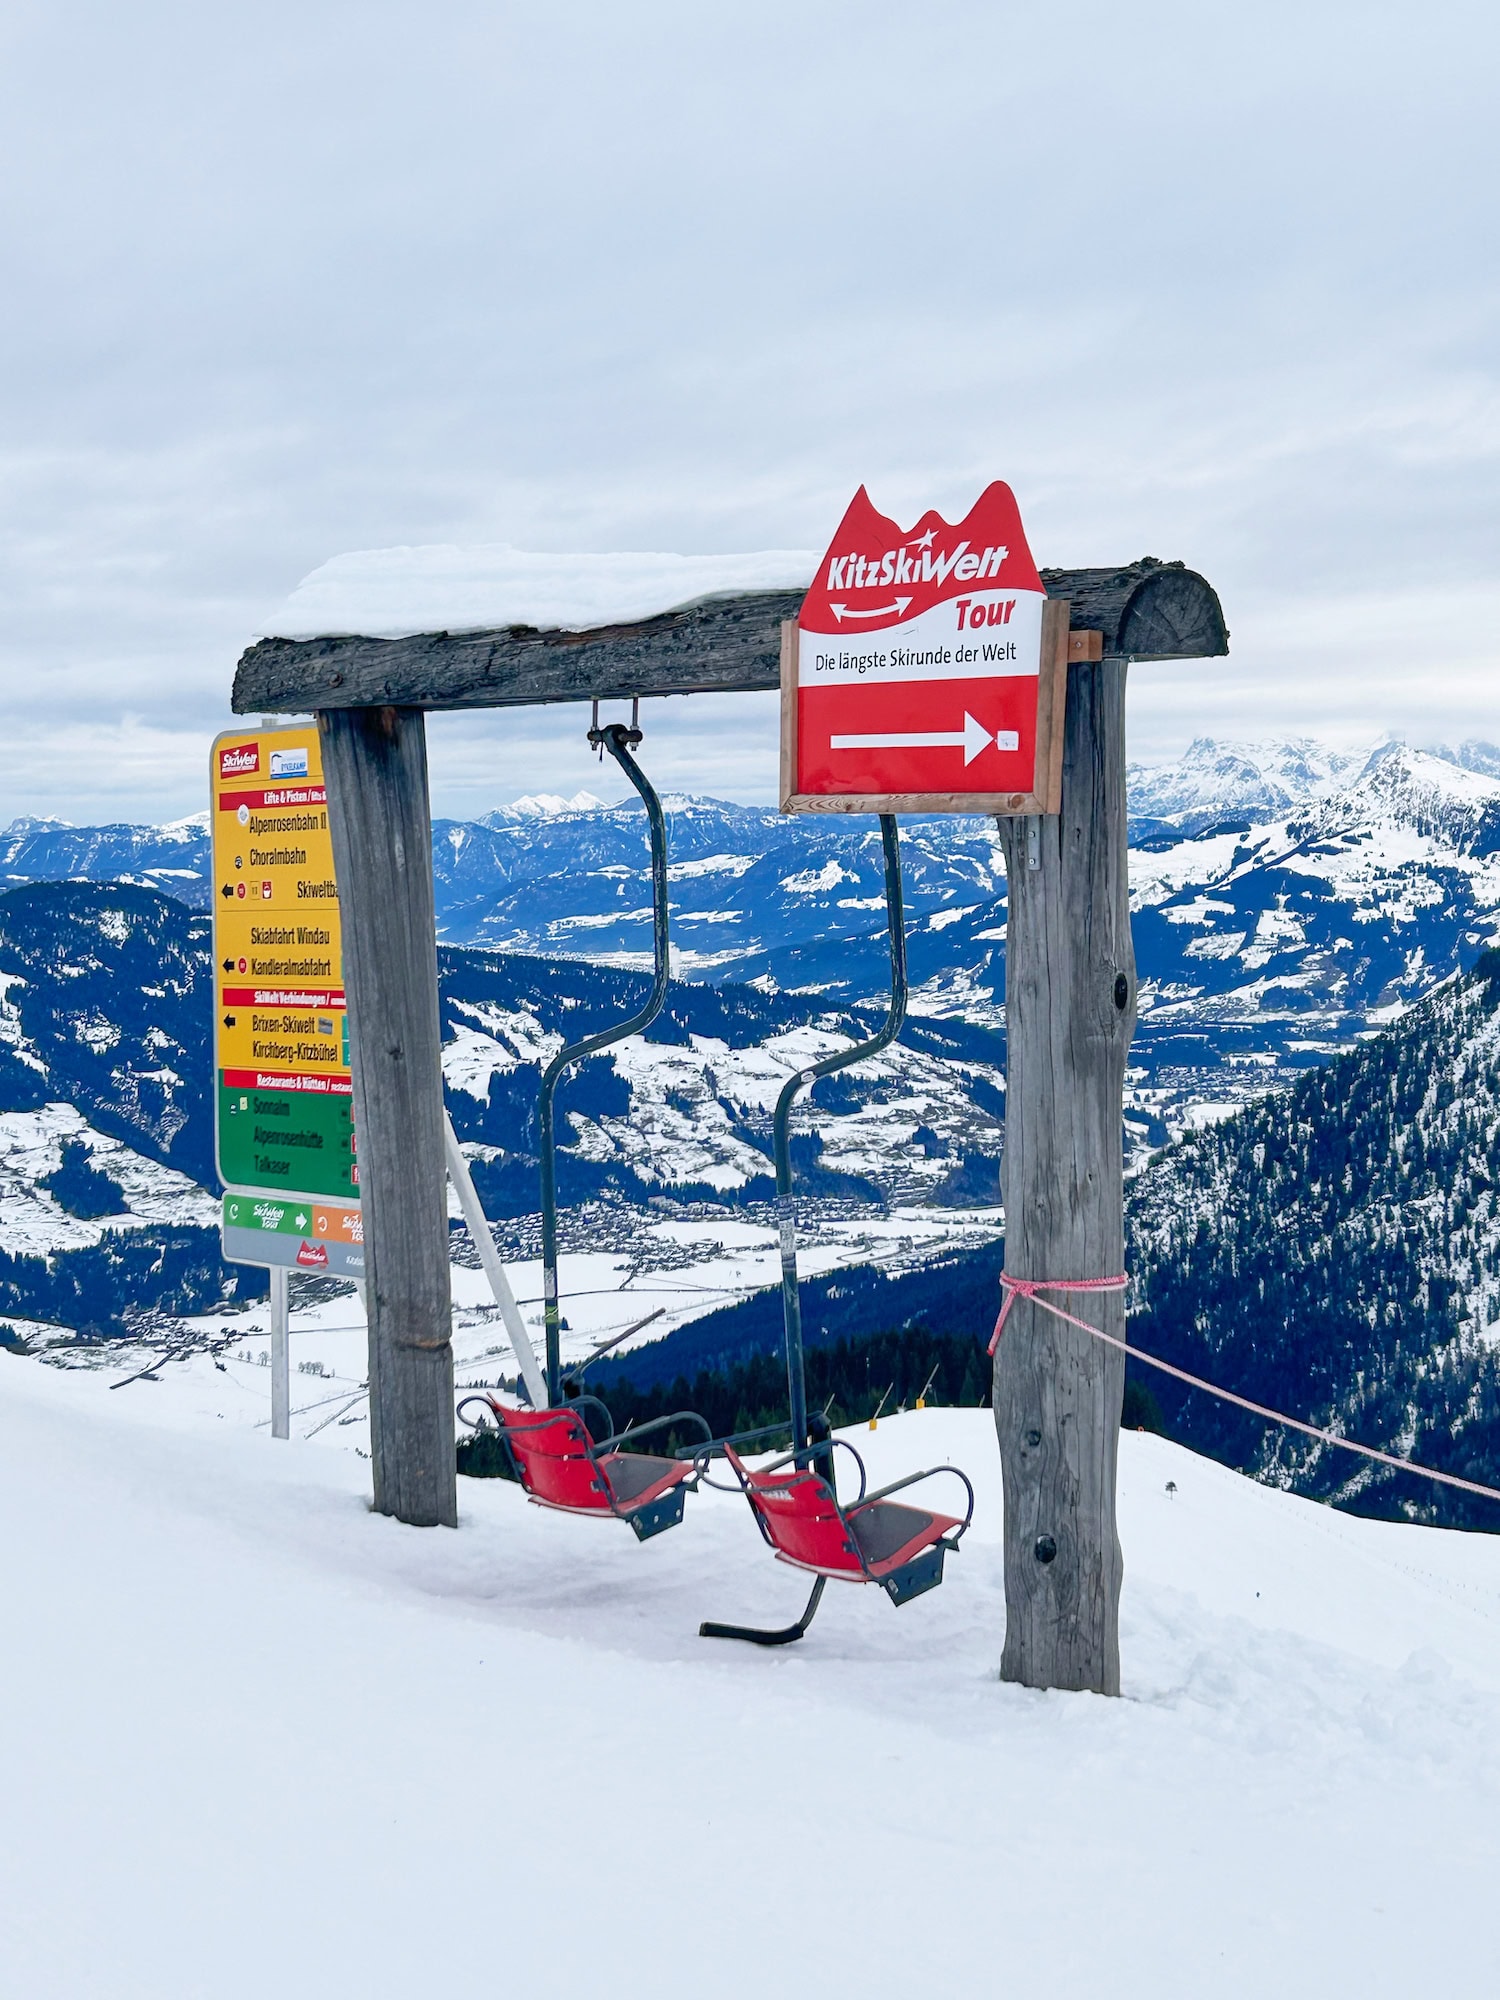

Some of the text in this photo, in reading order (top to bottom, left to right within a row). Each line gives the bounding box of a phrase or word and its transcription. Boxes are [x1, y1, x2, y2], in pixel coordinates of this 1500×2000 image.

[827, 541, 1010, 591] KitzSkiWelt
[956, 599, 1017, 631] Tour
[815, 641, 1017, 674] Die längste Skirunde der Welt
[222, 752, 257, 768] SkiWelt
[250, 812, 319, 836] Alpenrosenbahn
[250, 848, 307, 867] Choralmbahn
[251, 926, 330, 945] Skiabfahrt Windau
[251, 958, 332, 976] Kandleralmabfahrt
[252, 1014, 316, 1034] Brixen-Skiwelt
[253, 1040, 338, 1063] Kirchberg-Kitzbühel
[254, 1126, 324, 1149] Alpenrosenhütte
